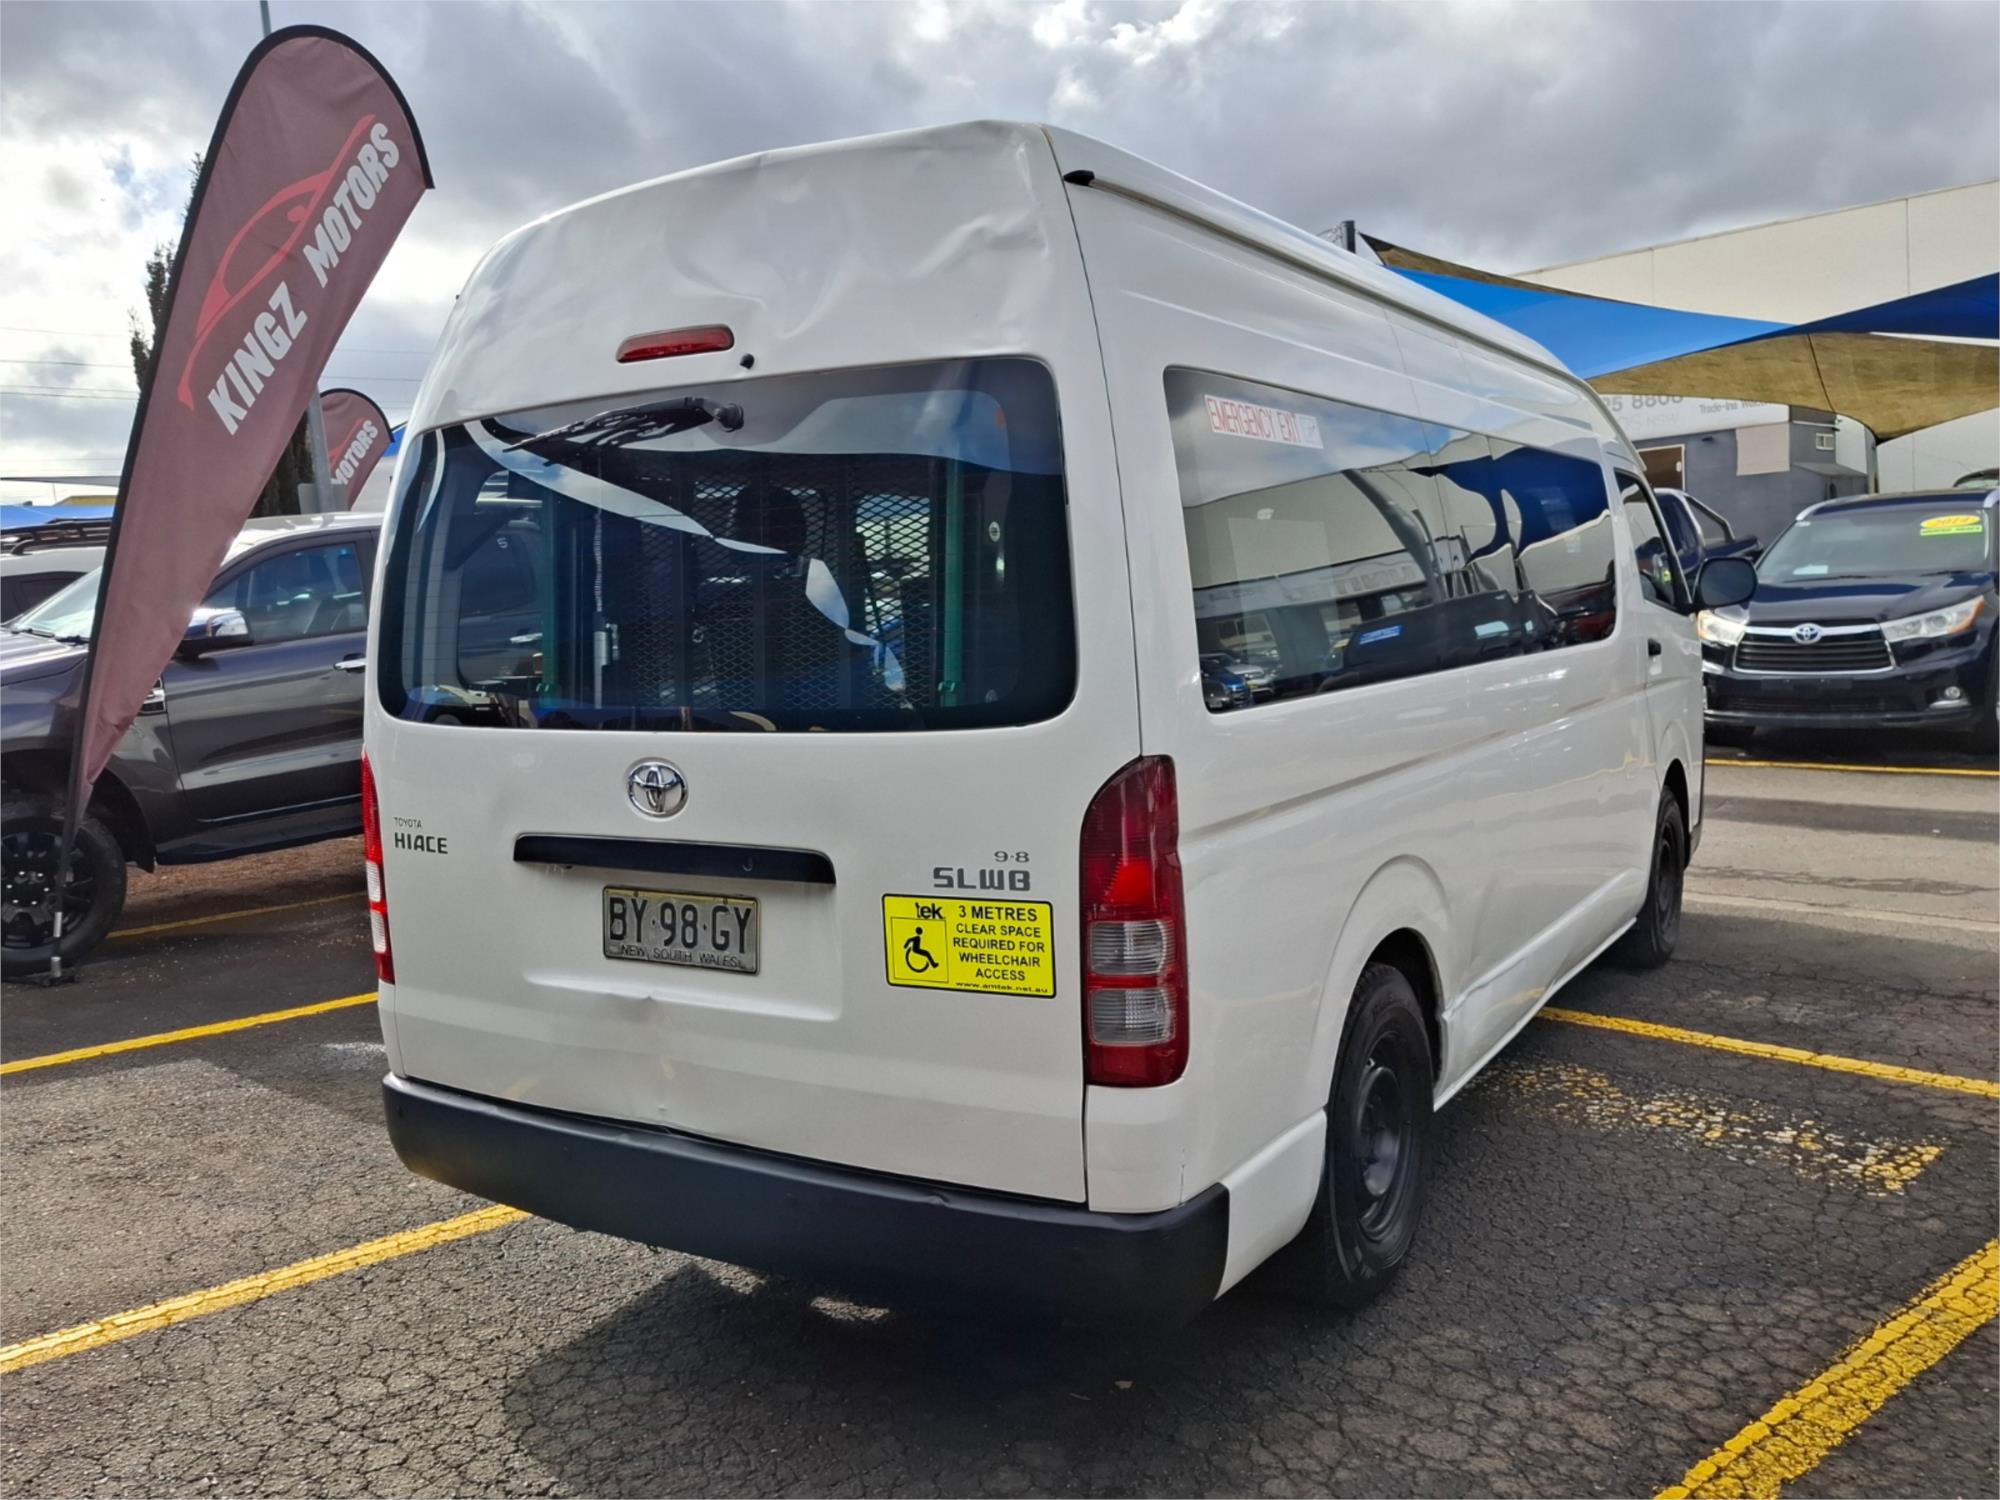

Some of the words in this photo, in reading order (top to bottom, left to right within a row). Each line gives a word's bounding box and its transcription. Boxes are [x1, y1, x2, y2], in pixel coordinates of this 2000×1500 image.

[208, 281, 308, 435] KINGZ
[303, 122, 399, 288] MOTORS
[1206, 397, 1278, 440] EMERGENCY
[394, 816, 422, 829] TOYOTA
[394, 832, 448, 855] HIACE
[933, 866, 1031, 892] SLWB
[958, 905, 967, 918] 3
[971, 906, 1038, 922] METRES
[956, 923, 996, 935] CLEAR
[1000, 925, 1041, 938] SPACE
[953, 937, 1015, 951] REQUIRED
[1018, 941, 1045, 953] FOR
[621, 944, 645, 958] NEW
[653, 948, 693, 963] SOUTH
[699, 953, 738, 968] WALES
[959, 952, 1041, 967] WHEELCHAIR
[975, 968, 1026, 981] ACCESS
